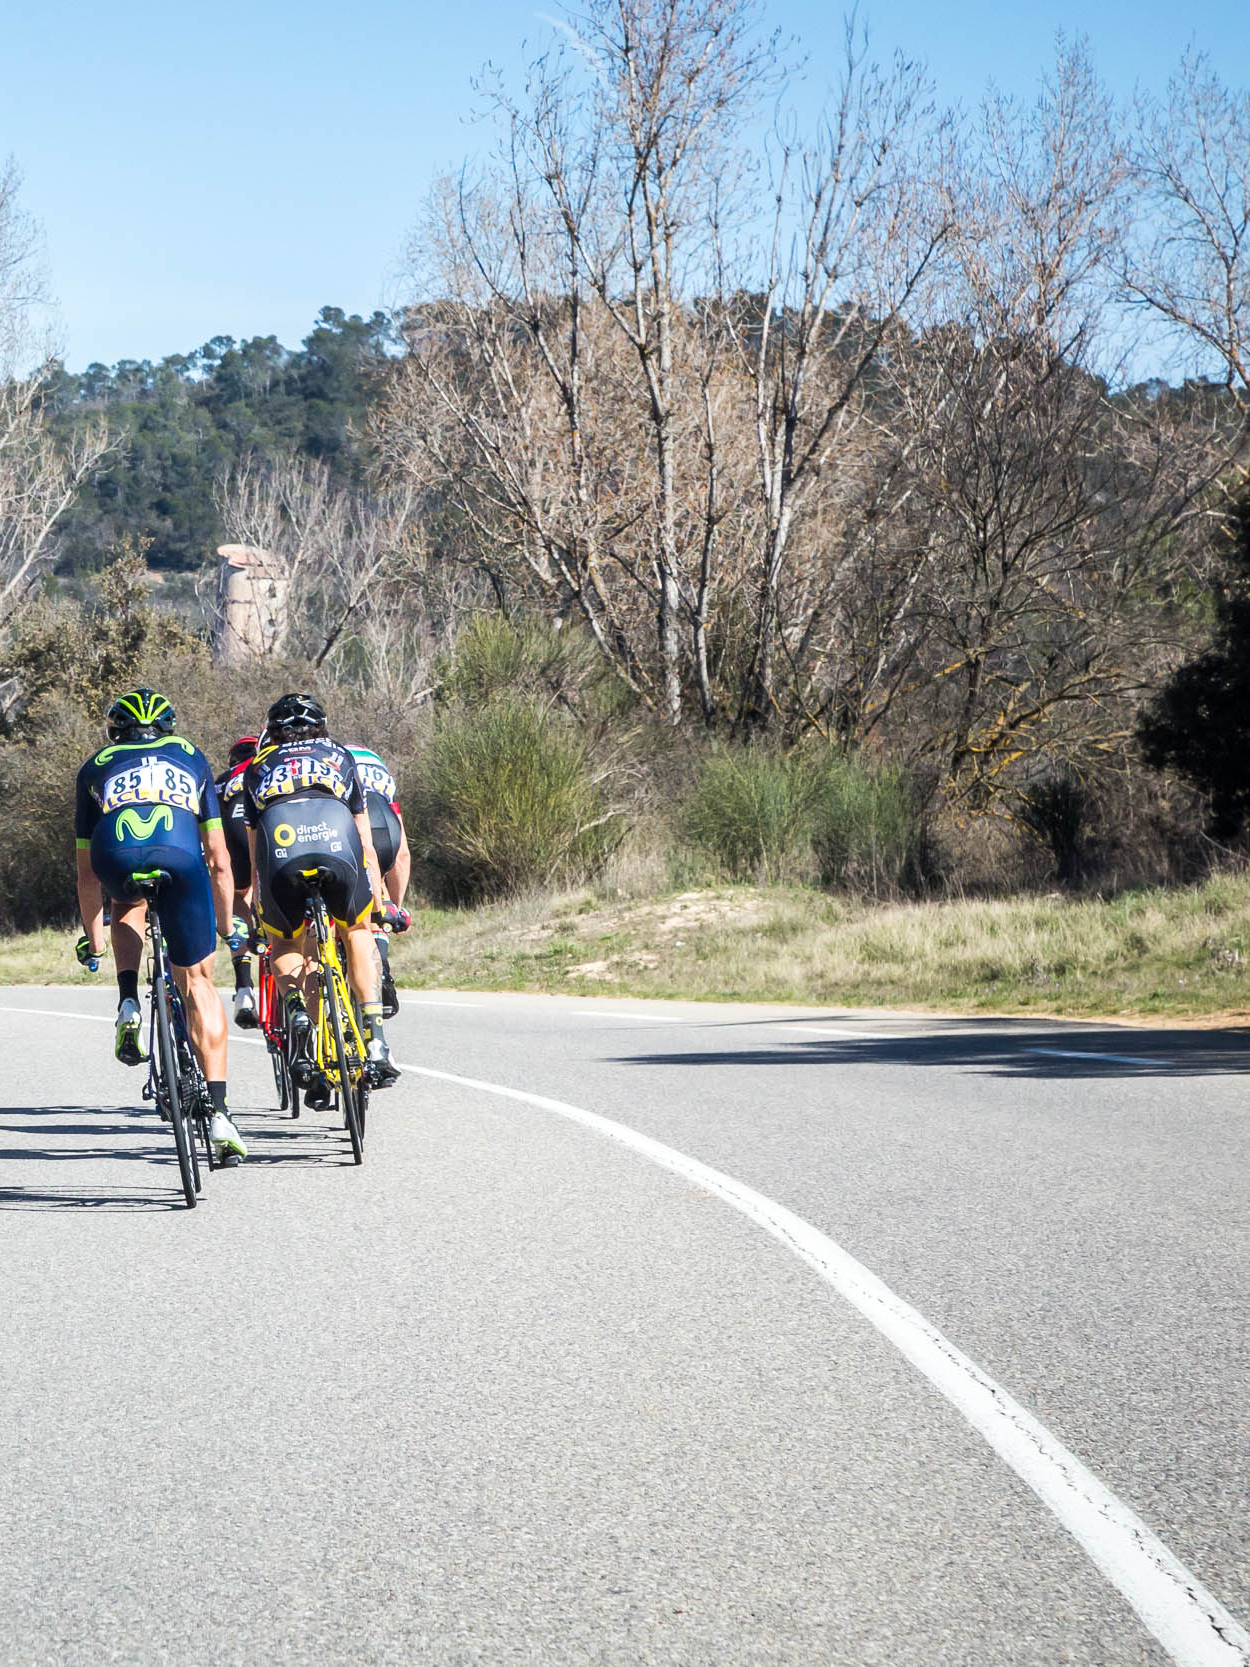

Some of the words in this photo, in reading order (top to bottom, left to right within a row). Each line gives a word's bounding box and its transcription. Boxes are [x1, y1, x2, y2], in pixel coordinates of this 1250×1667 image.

[113, 770, 142, 795] 85
[165, 768, 192, 795] 85
[107, 789, 148, 808] LCL
[159, 789, 195, 813] LCL
[297, 821, 328, 835] direct
[297, 829, 338, 843] energie
